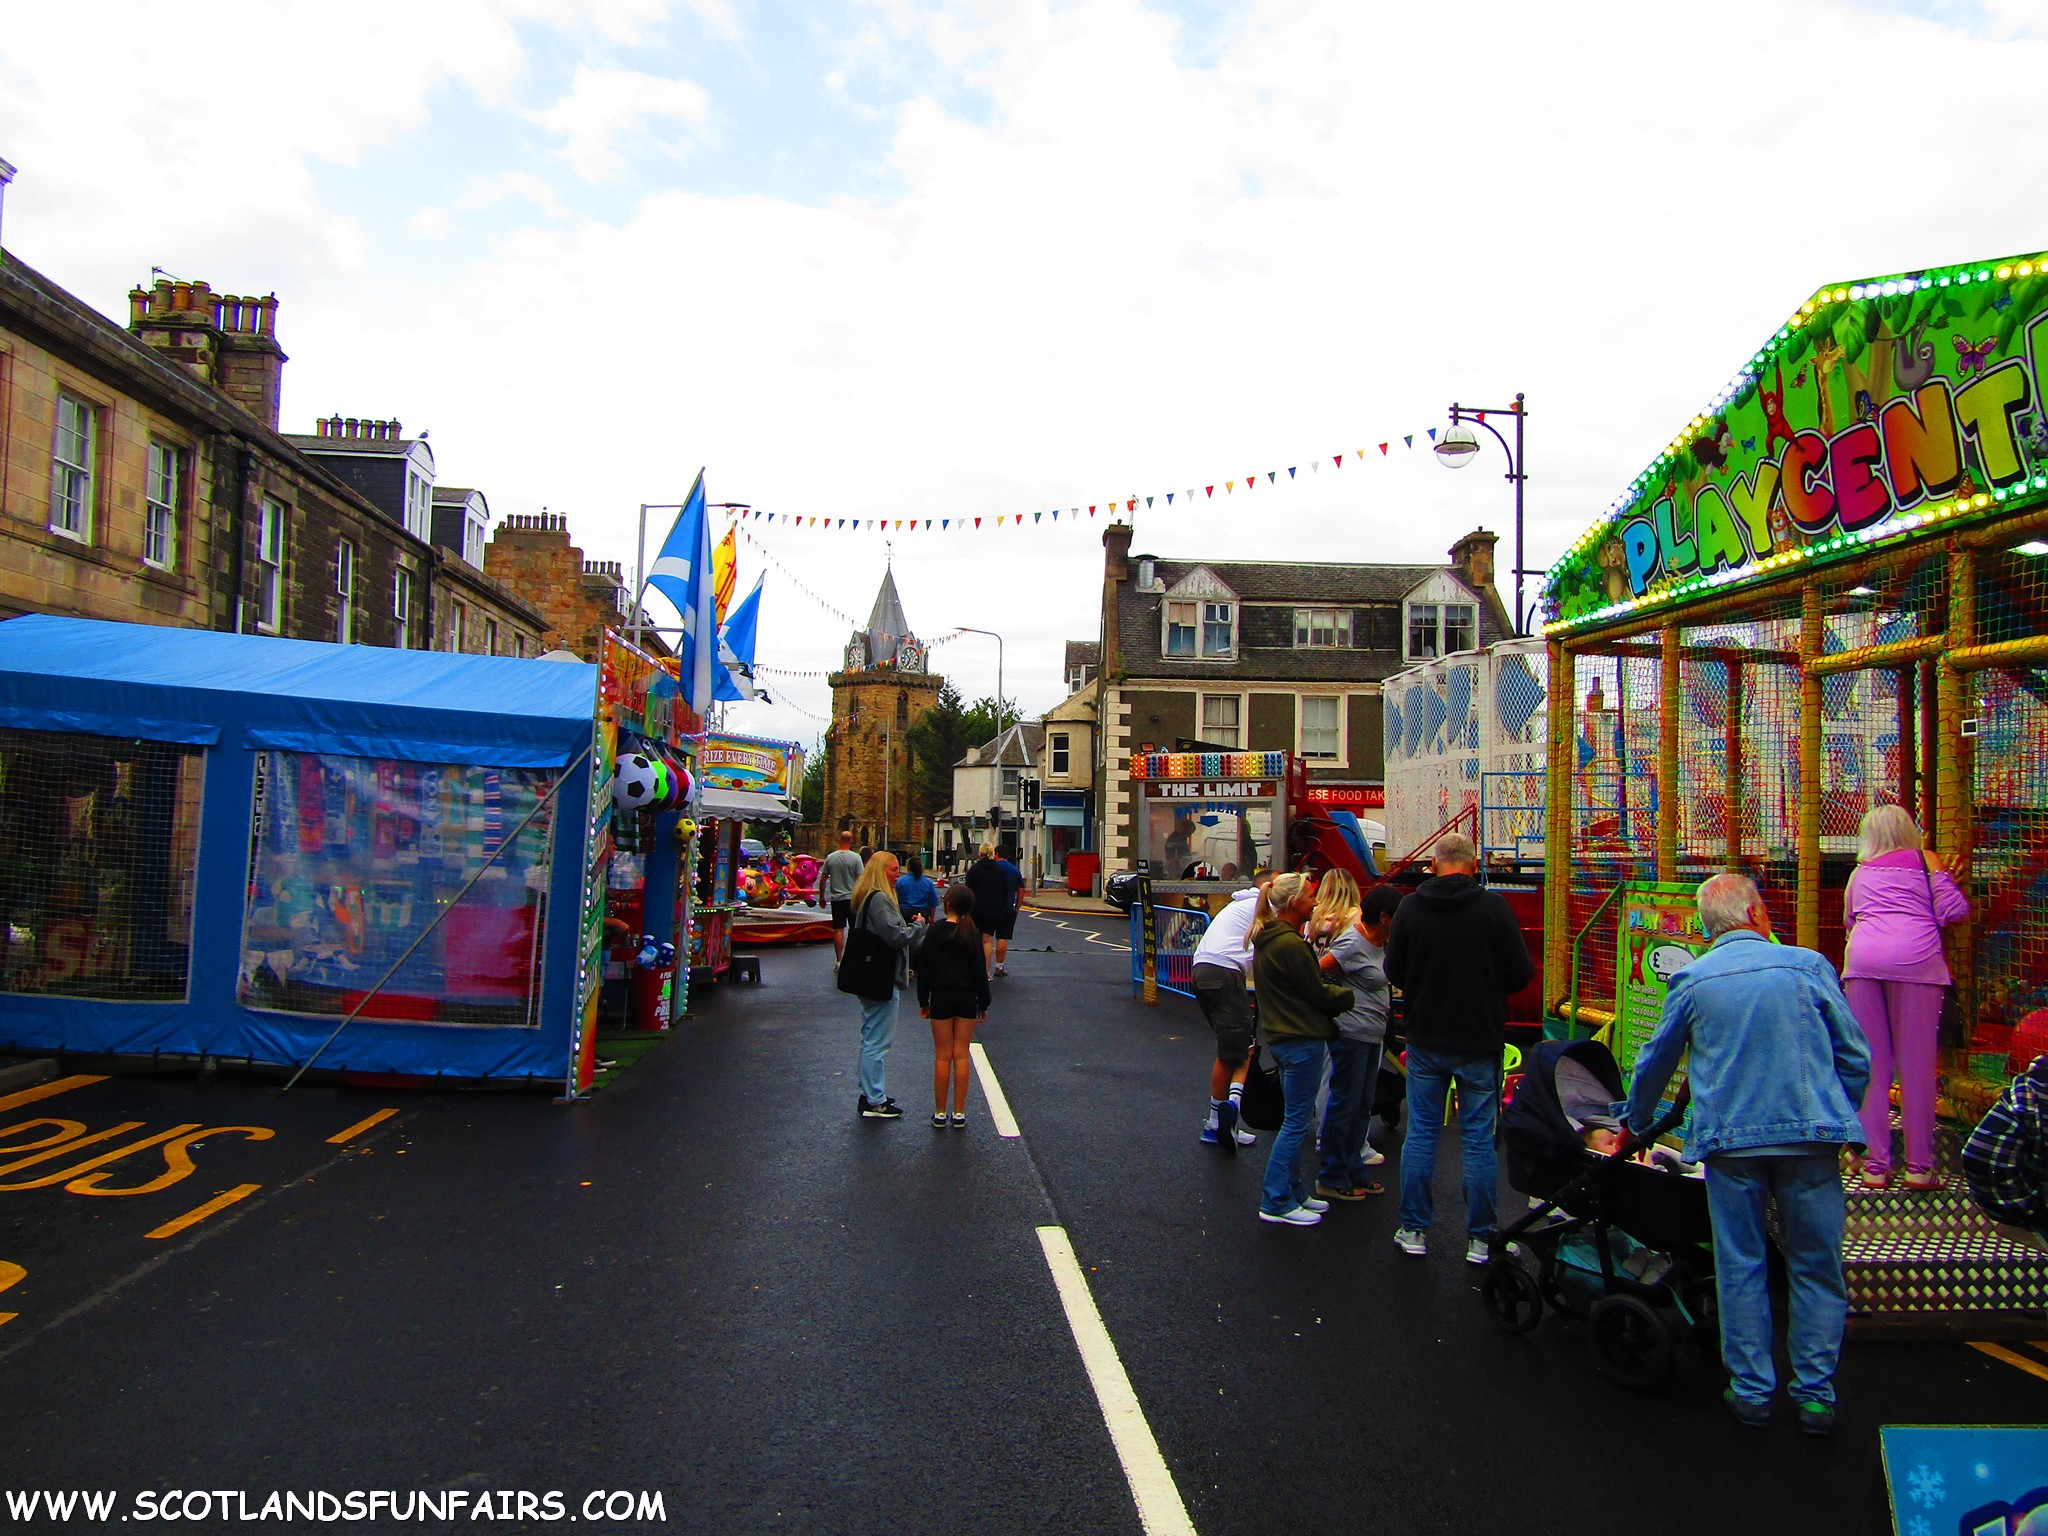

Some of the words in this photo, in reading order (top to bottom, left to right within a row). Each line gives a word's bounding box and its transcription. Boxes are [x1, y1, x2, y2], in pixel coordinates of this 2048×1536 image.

[1619, 458, 1782, 599] PLAY
[1780, 308, 2048, 535] CENT
[726, 751, 754, 766] EVERY
[755, 754, 777, 773] TIME
[1158, 783, 1199, 797] THE
[1204, 782, 1262, 797] LIMIT
[1332, 790, 1362, 801] FOOD
[1629, 909, 1660, 932] PLAY
